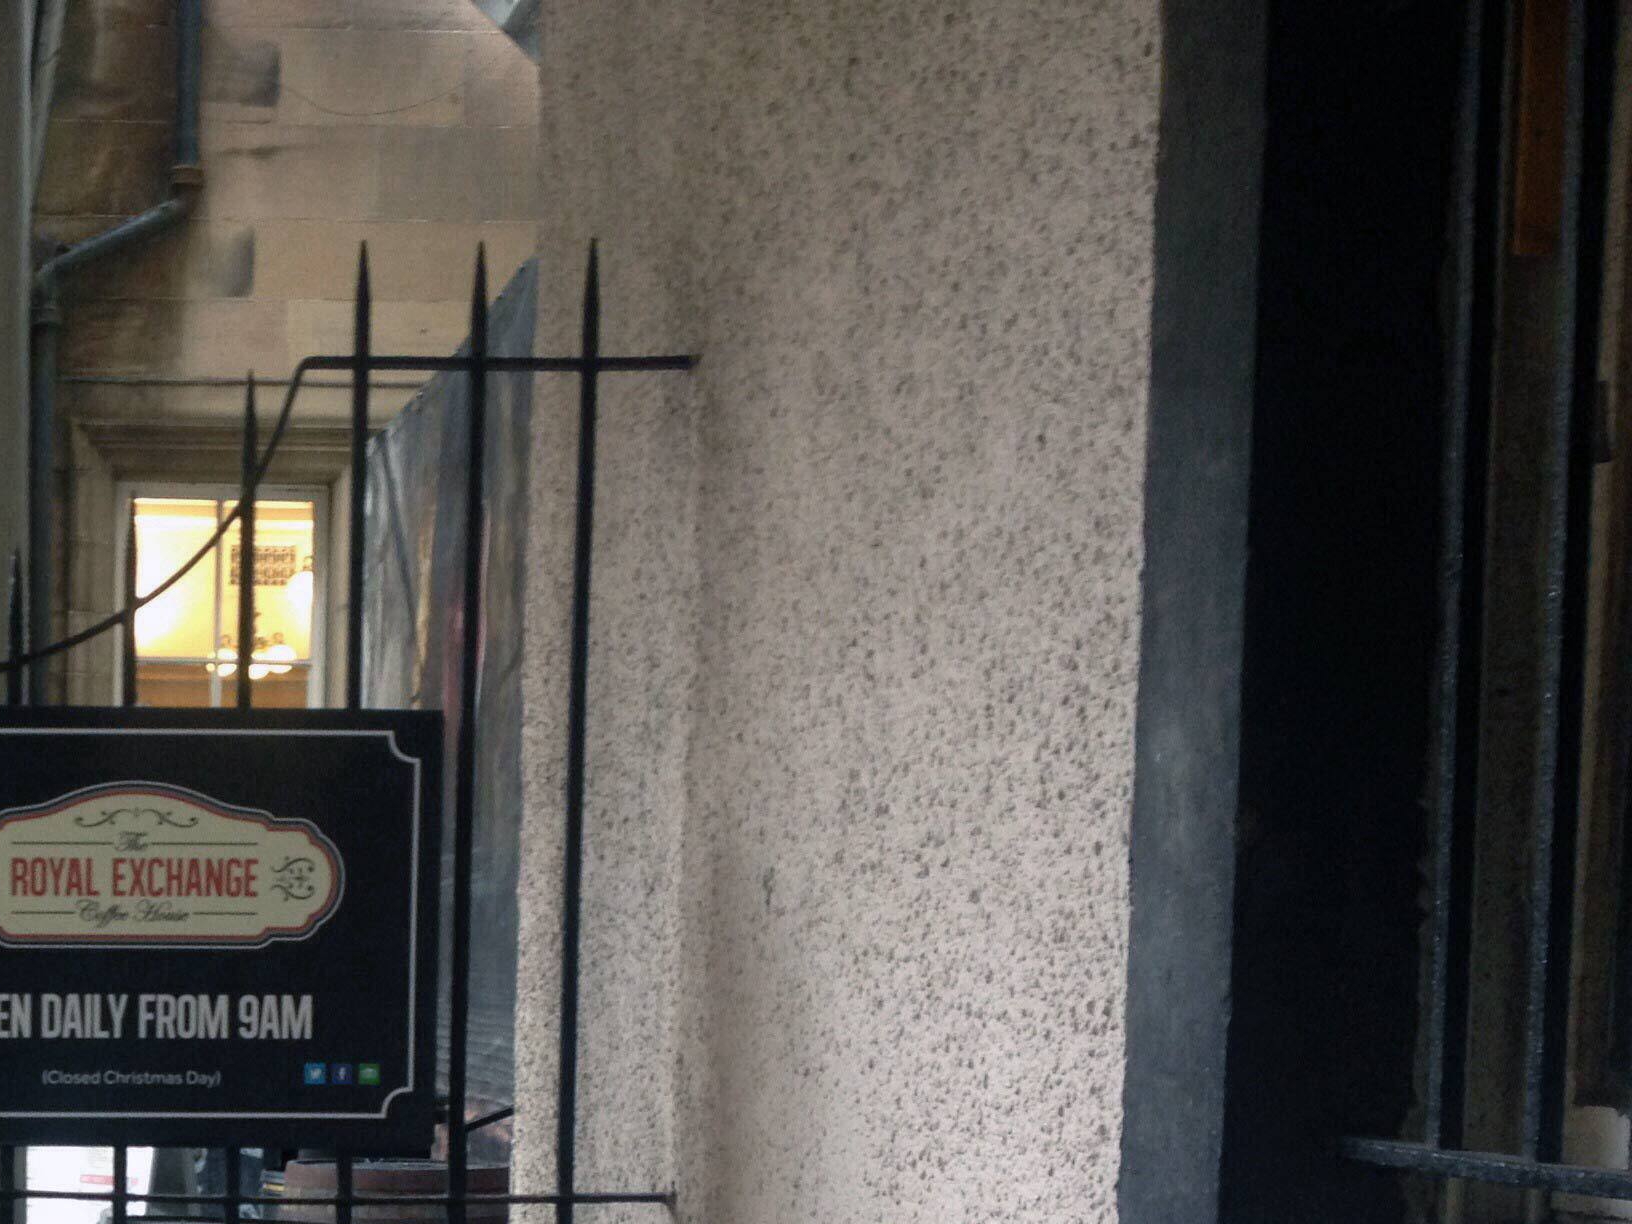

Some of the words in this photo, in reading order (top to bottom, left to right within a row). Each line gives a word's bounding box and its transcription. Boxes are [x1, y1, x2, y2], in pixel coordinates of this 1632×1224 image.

[10, 856, 101, 898] ROYAL
[111, 857, 260, 898] EXCHANGE
[40, 993, 128, 1040] DAILY
[137, 993, 230, 1040] FROM
[237, 993, 313, 1041] 9AM
[41, 1069, 101, 1087] (Closed
[102, 1069, 184, 1086] Christmas
[185, 1070, 222, 1088] Day)
